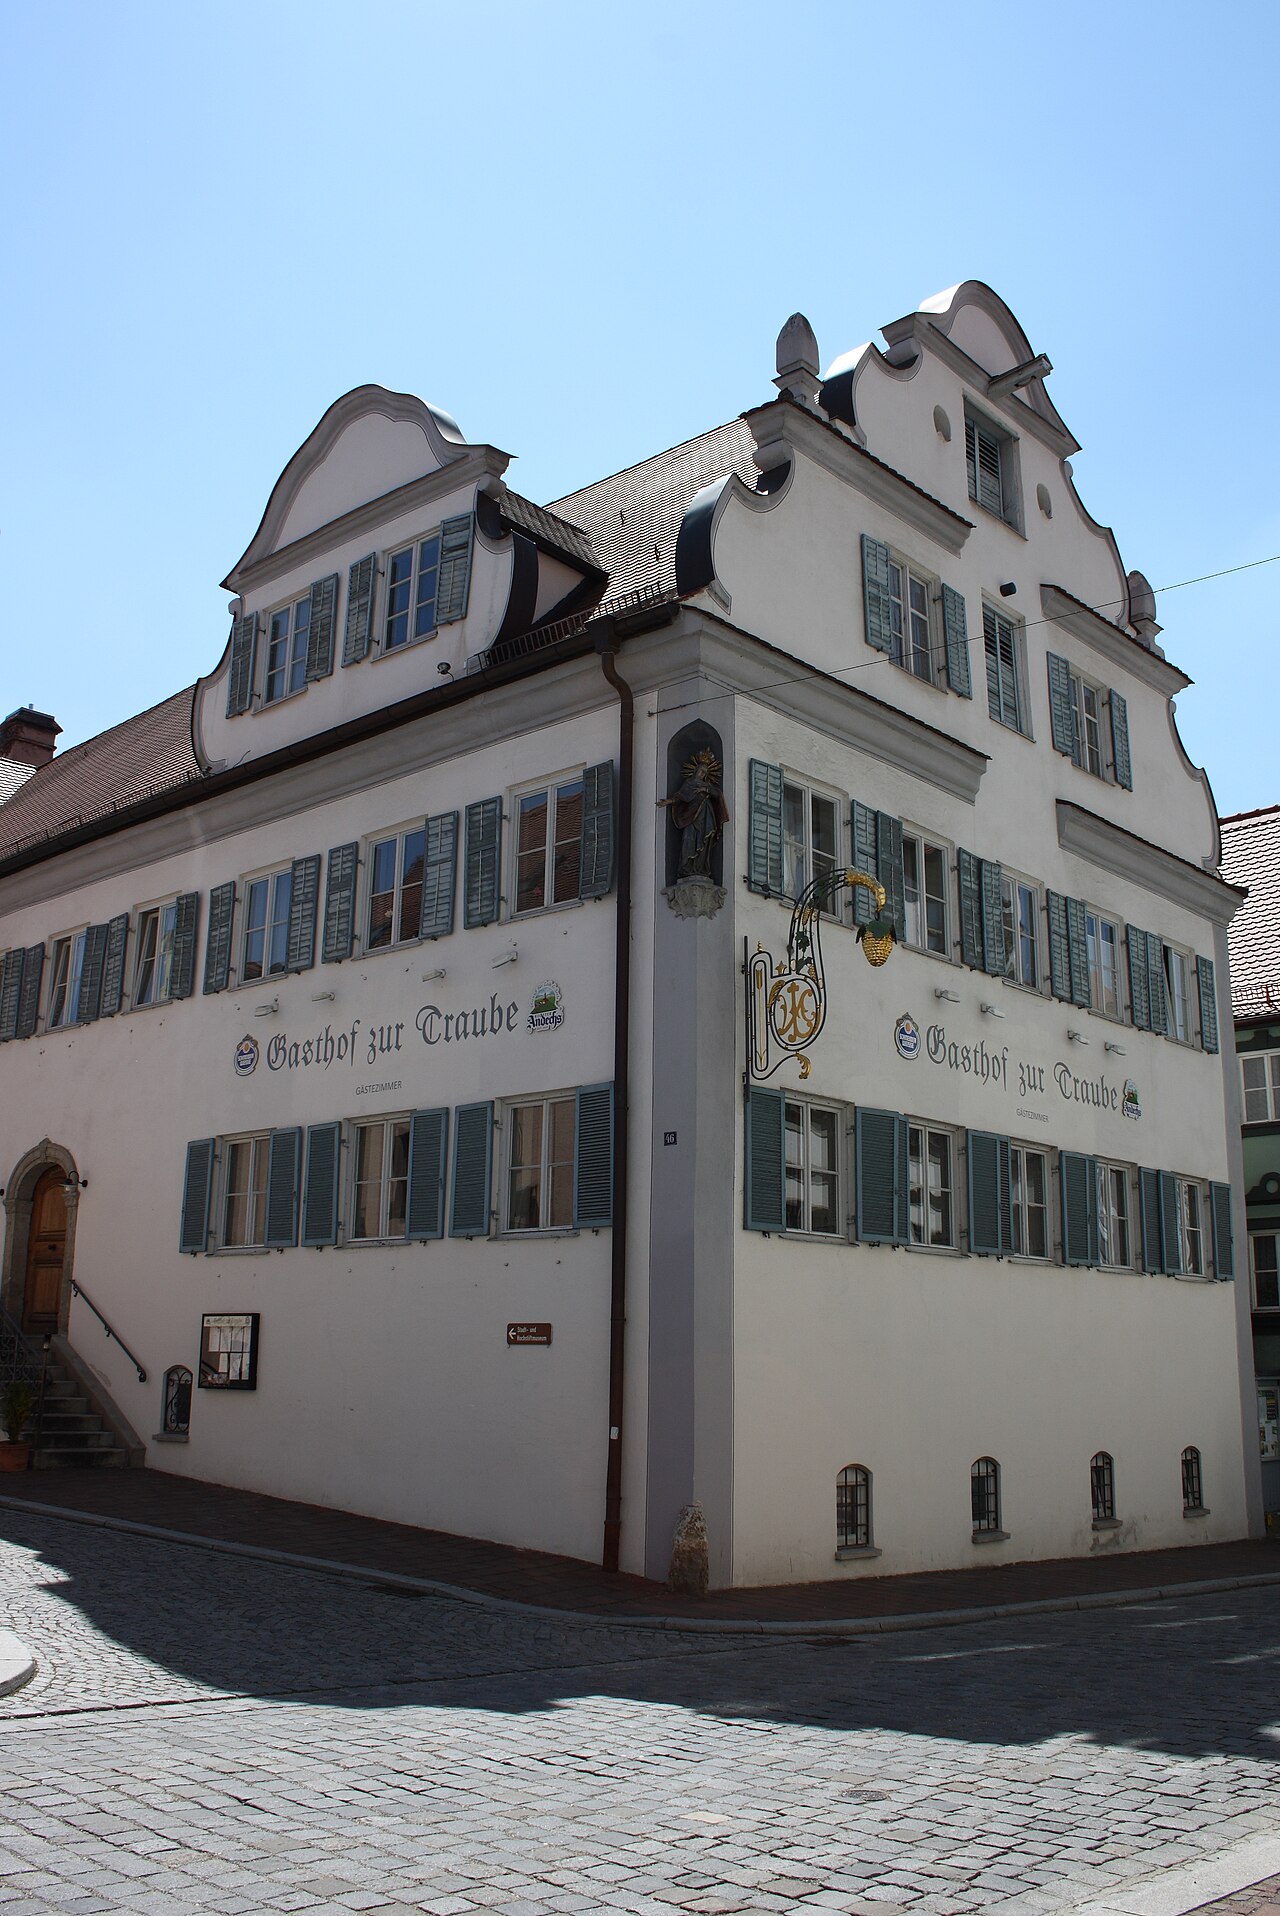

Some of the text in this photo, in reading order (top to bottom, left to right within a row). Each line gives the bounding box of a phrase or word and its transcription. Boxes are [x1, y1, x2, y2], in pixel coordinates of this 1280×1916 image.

[526, 1010, 562, 1029] Andechs
[266, 1019, 361, 1071] Gasthof
[367, 1020, 405, 1065] zur
[415, 992, 519, 1046] Traube
[926, 1024, 1118, 1111] Gasthof zur Traube
[355, 1080, 402, 1096] GÄSTEZIMMER
[1016, 1107, 1050, 1124] GÄSTEZIMMER
[665, 1133, 675, 1144] 46
